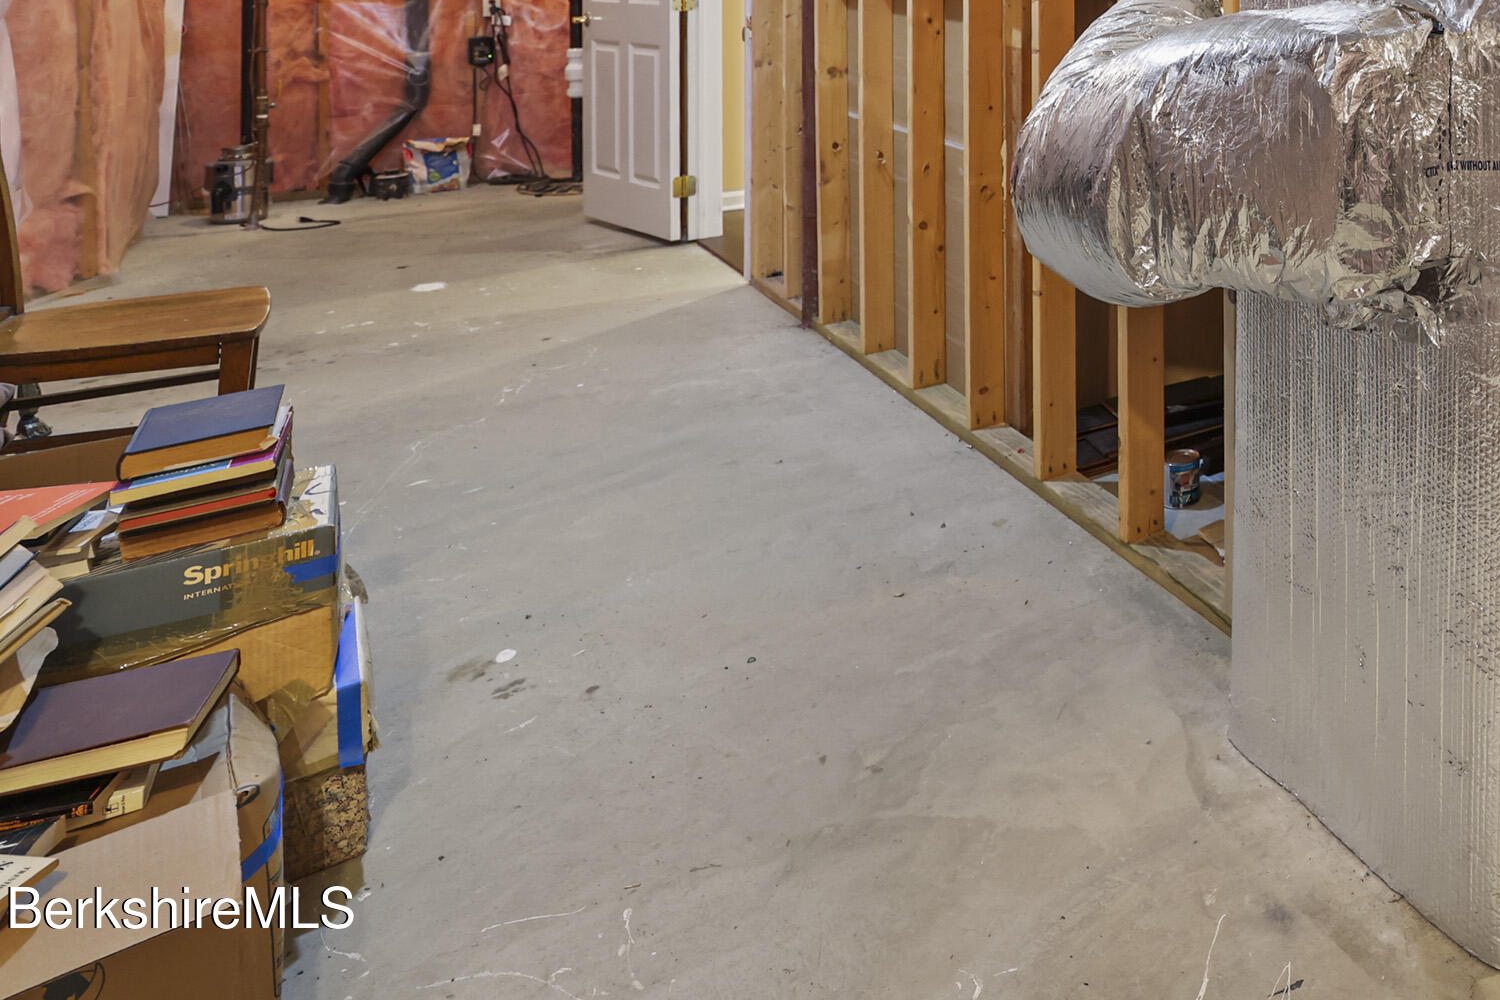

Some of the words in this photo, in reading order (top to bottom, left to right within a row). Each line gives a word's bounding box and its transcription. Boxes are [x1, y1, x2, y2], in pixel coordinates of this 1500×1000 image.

[1460, 160, 1491, 171] WITHOUT
[183, 539, 315, 586] Sprinhill
[183, 584, 234, 601] INTERNAT
